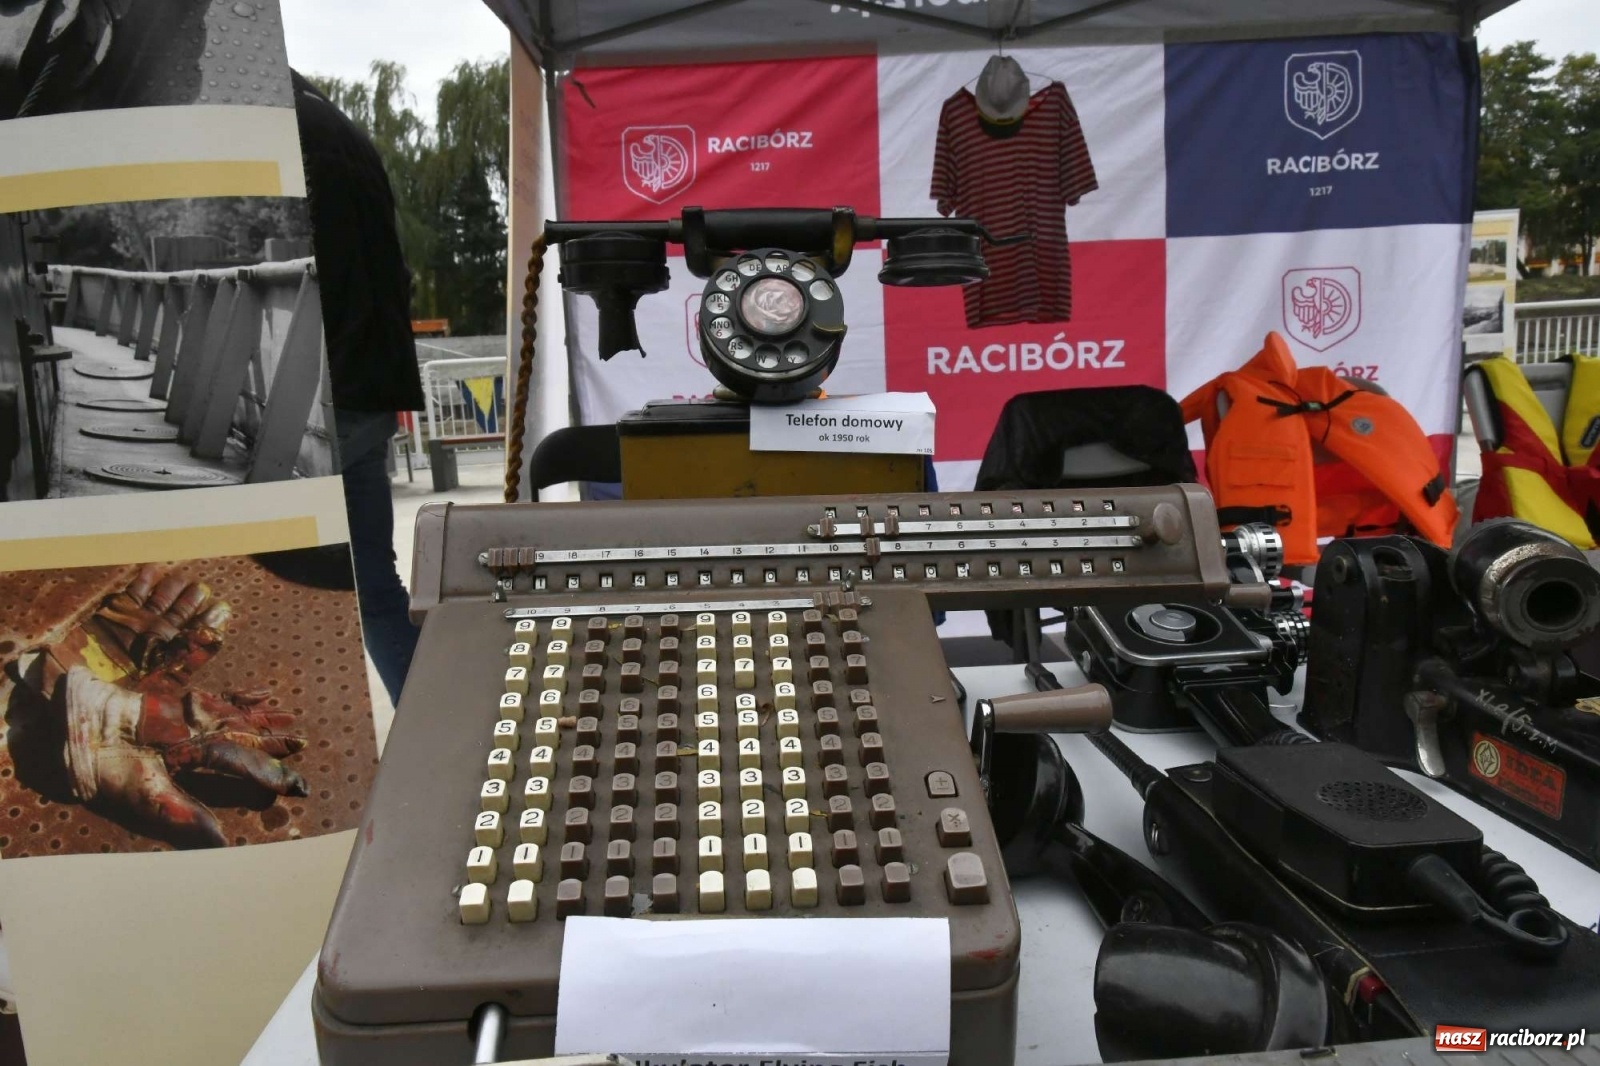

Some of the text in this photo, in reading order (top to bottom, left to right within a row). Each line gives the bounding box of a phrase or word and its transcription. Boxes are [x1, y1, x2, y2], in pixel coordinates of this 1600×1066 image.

[707, 129, 813, 153] RACIBÓRZ
[750, 162, 770, 172] 1217
[1266, 148, 1380, 175] RACIBÓRZ
[1309, 186, 1333, 197] 1217
[927, 332, 1126, 374] RACIBÓRZ
[785, 413, 903, 431] Telefon domowy
[818, 433, 871, 443] ok 1950 rok
[700, 548, 709, 556] 14
[733, 547, 742, 555] 13
[512, 669, 522, 677] 7
[505, 696, 516, 704] 6
[544, 693, 555, 701] 6
[740, 697, 751, 705] 6
[499, 723, 511, 732] 5
[540, 720, 552, 729] 5
[703, 715, 714, 724] 5
[743, 713, 754, 722] 5
[783, 712, 794, 721] 5
[493, 751, 506, 760] 4
[535, 749, 546, 758] 4
[704, 742, 714, 752] 4
[744, 741, 755, 751] 4
[785, 740, 796, 749] 4
[486, 783, 500, 793] 3
[530, 781, 542, 790] 3
[703, 773, 715, 784] 3
[744, 772, 758, 782] 3
[788, 770, 800, 780] 3
[480, 815, 493, 825] 2
[525, 812, 538, 823] 2
[704, 805, 716, 816] 2
[746, 804, 759, 814] 2
[790, 802, 804, 813] 2
